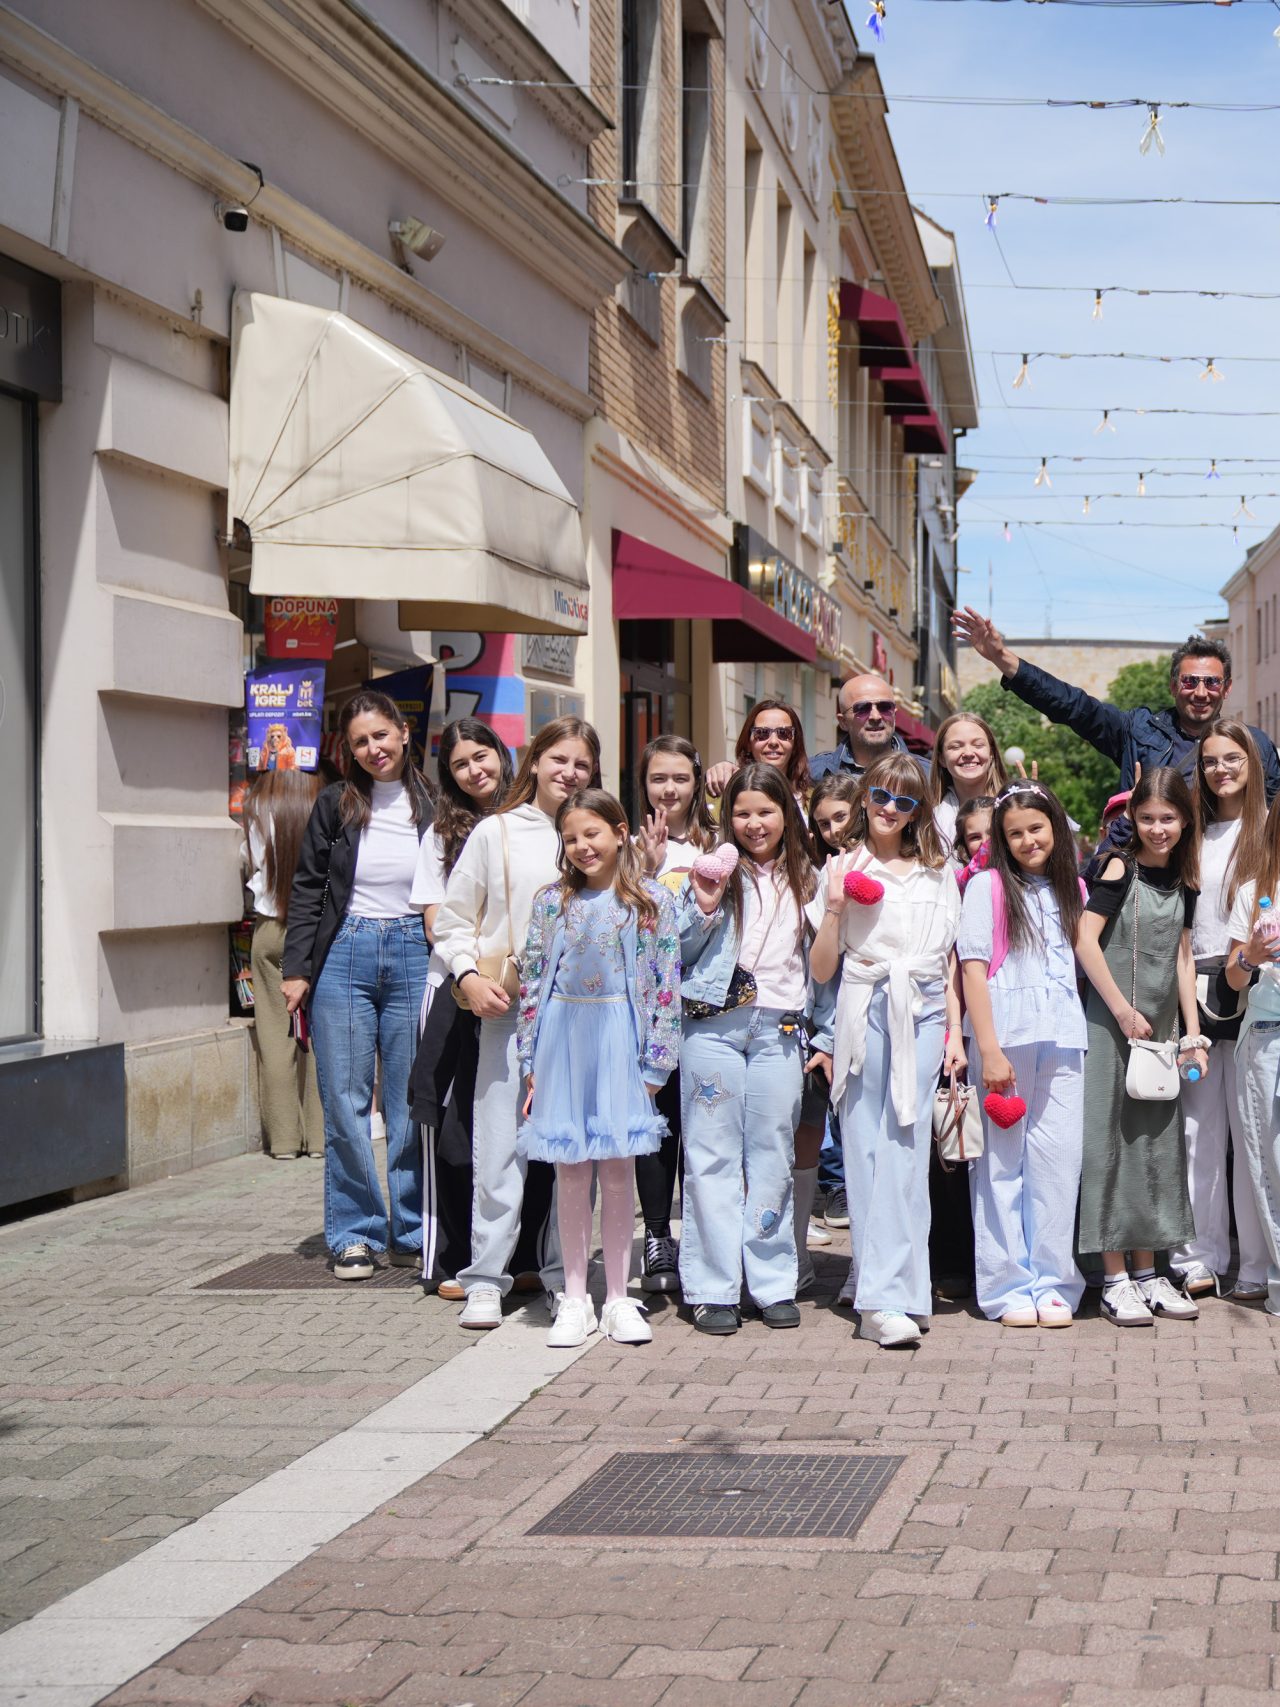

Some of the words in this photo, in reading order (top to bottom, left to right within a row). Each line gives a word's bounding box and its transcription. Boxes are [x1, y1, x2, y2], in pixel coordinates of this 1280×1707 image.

[272, 599, 338, 614] DOPUNA
[250, 684, 294, 696] KRALJ
[255, 696, 286, 707] IGRE
